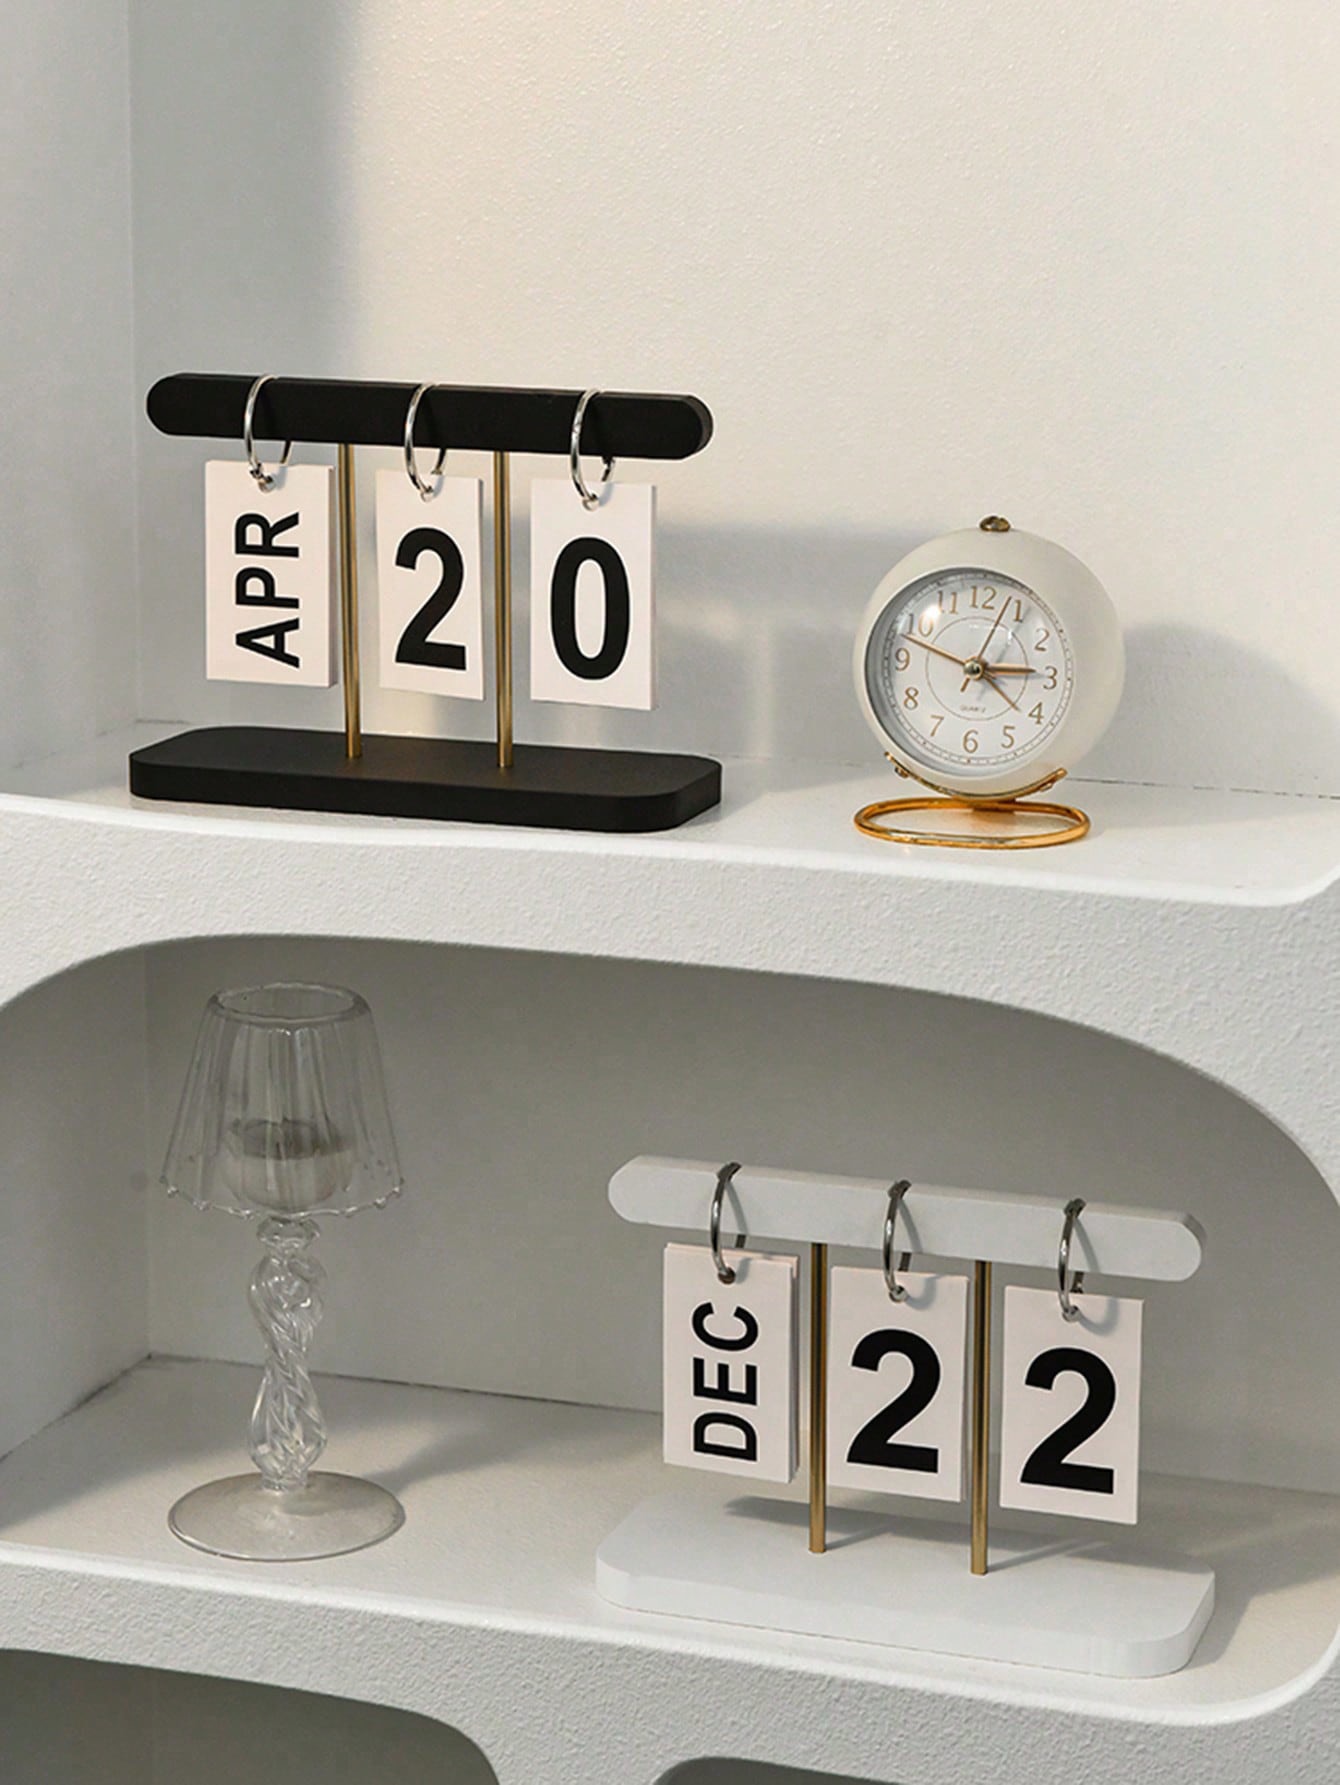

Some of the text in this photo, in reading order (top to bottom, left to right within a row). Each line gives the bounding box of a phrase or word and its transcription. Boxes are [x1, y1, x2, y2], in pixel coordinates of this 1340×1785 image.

[235, 511, 630, 680] APR 2 0
[937, 590, 958, 615] 11
[970, 586, 997, 610] 12
[1014, 599, 1023, 623] 1
[907, 613, 934, 637] 10
[1034, 628, 1050, 651] 2
[895, 647, 910, 671] 9
[1043, 666, 1057, 690] 3
[903, 687, 919, 710] 8
[1028, 702, 1044, 724] 4
[930, 715, 944, 737] 7
[1001, 726, 1015, 749] 5
[963, 729, 978, 753] 6
[691, 1302, 1116, 1495] DEC 2 2
